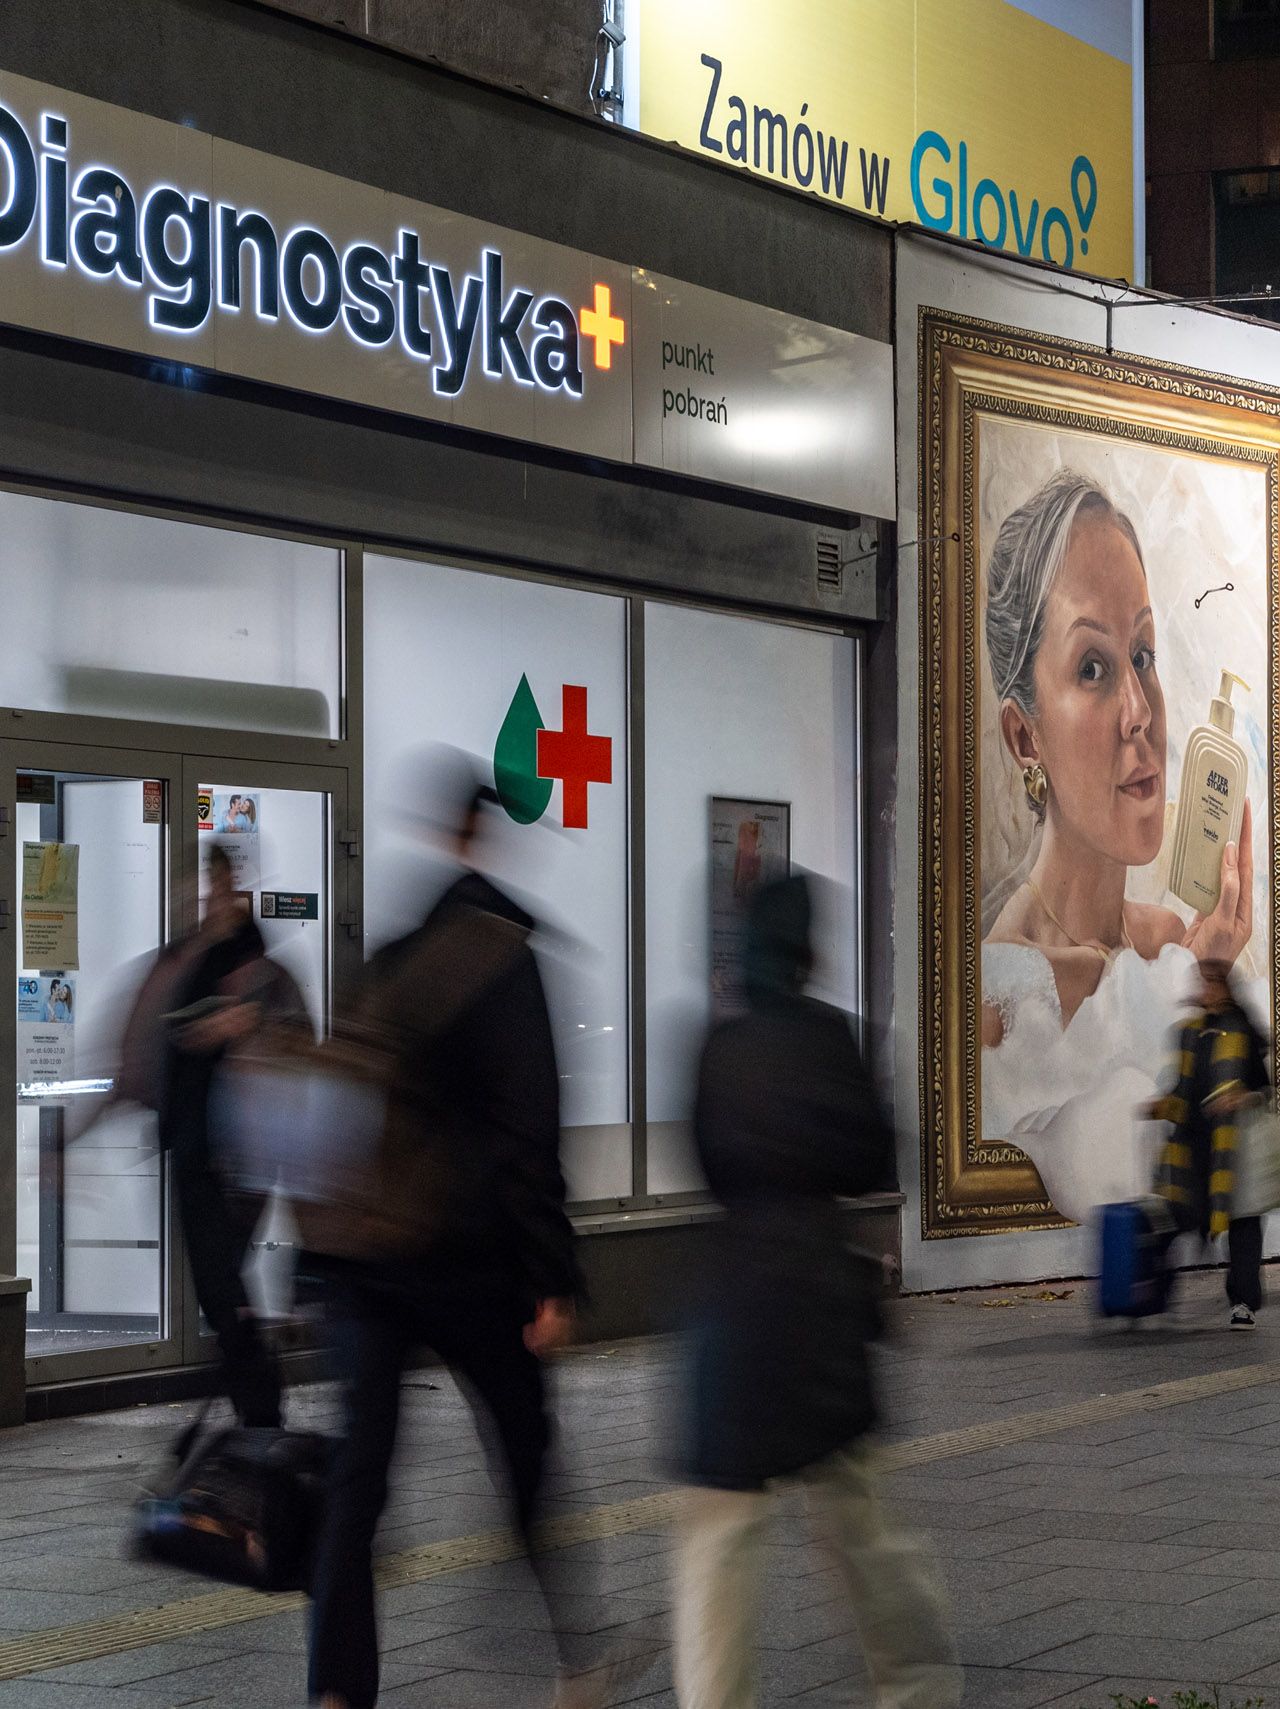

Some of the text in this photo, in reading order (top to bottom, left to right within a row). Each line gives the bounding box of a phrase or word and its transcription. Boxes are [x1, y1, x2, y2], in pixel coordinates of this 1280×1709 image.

[700, 53, 1074, 269] Zamów w Glovo
[662, 340, 715, 376] punkt
[662, 386, 728, 426] pobrań
[1206, 778, 1228, 797] STORM
[1208, 770, 1228, 787] AFTER
